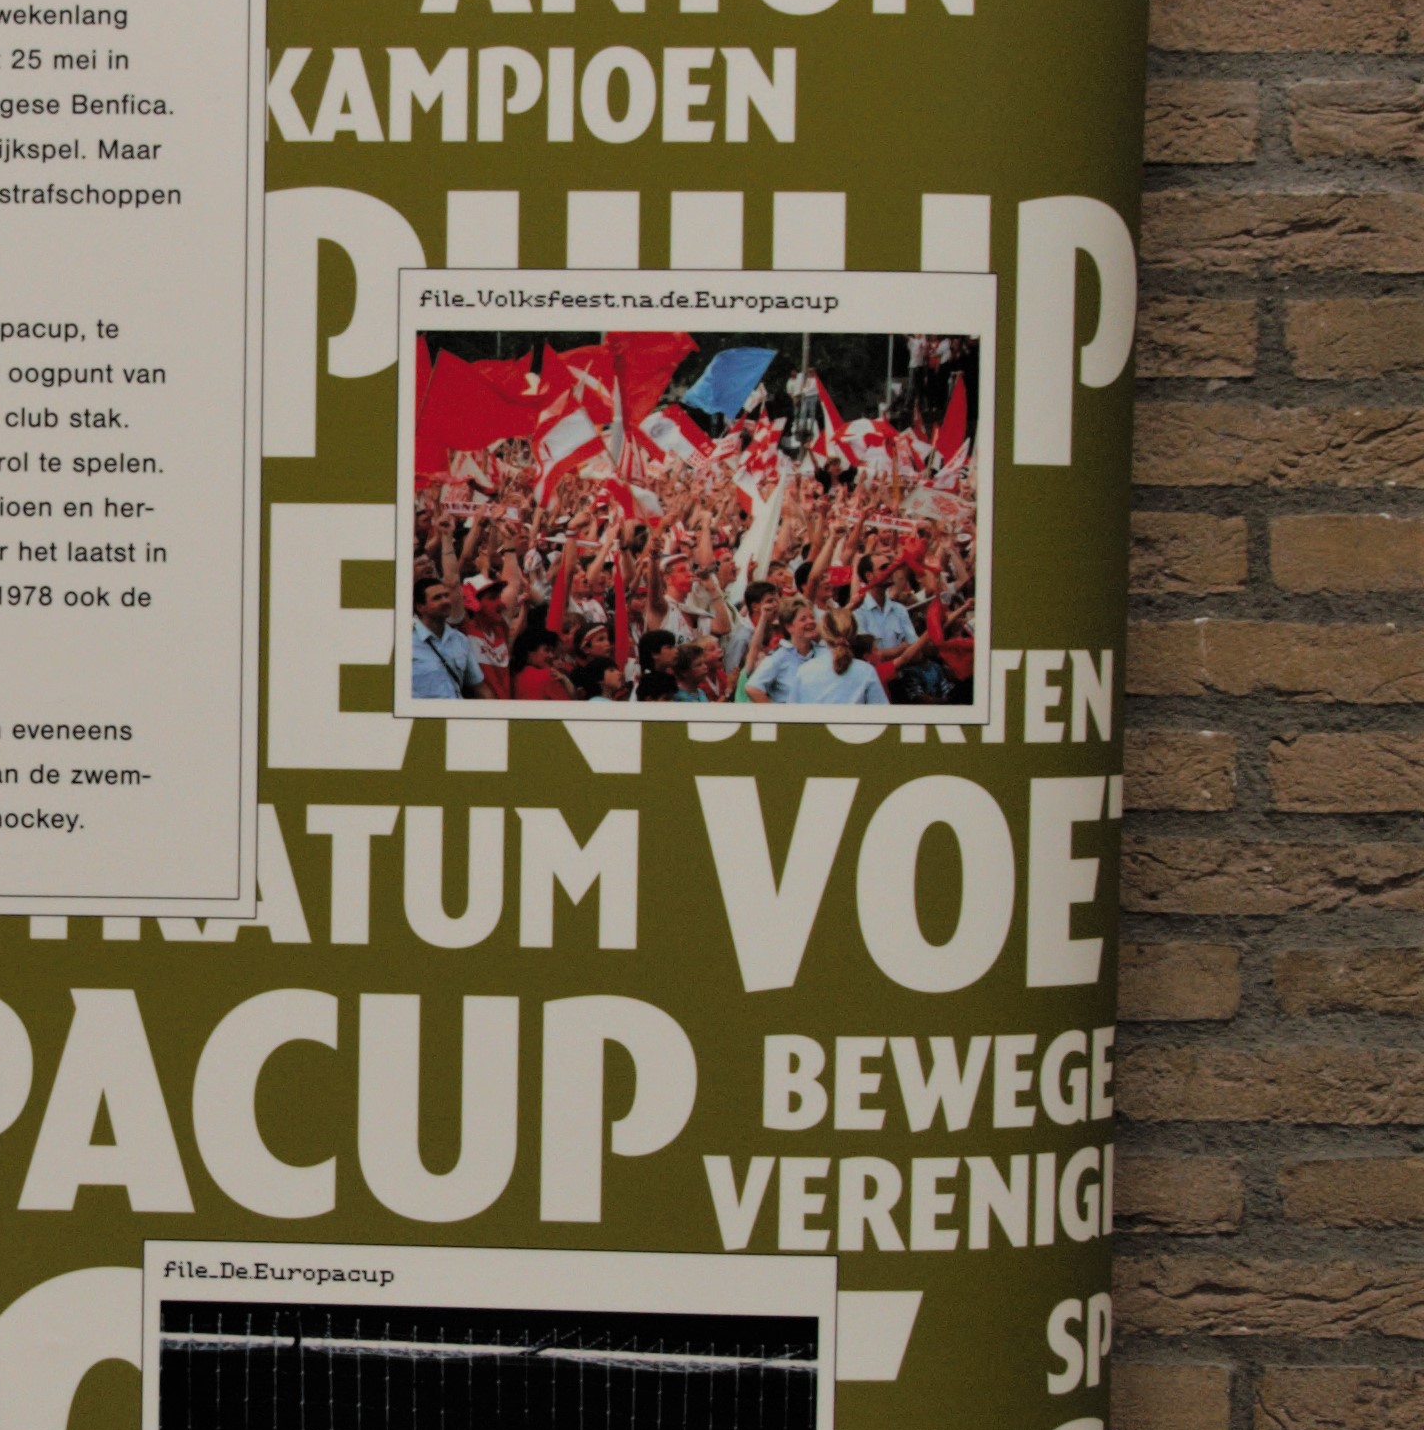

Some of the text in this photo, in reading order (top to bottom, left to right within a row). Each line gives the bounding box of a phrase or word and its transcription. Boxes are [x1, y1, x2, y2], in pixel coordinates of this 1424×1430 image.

[10, 48, 43, 71] 25
[53, 49, 97, 71] mei
[107, 49, 129, 71] in
[97, 138, 163, 161] Maar
[96, 318, 120, 340] te
[7, 363, 114, 388] oogpunt
[122, 367, 167, 385] van
[38, 452, 62, 474] te
[72, 452, 164, 478] spelen.
[18, 540, 58, 563] het
[67, 541, 137, 564] laatst
[145, 541, 167, 563] in
[11, 723, 133, 742] eveneens
[29, 763, 61, 785] de
[70, 768, 152, 786] zwem-
[694, 774, 1120, 993] VOE
